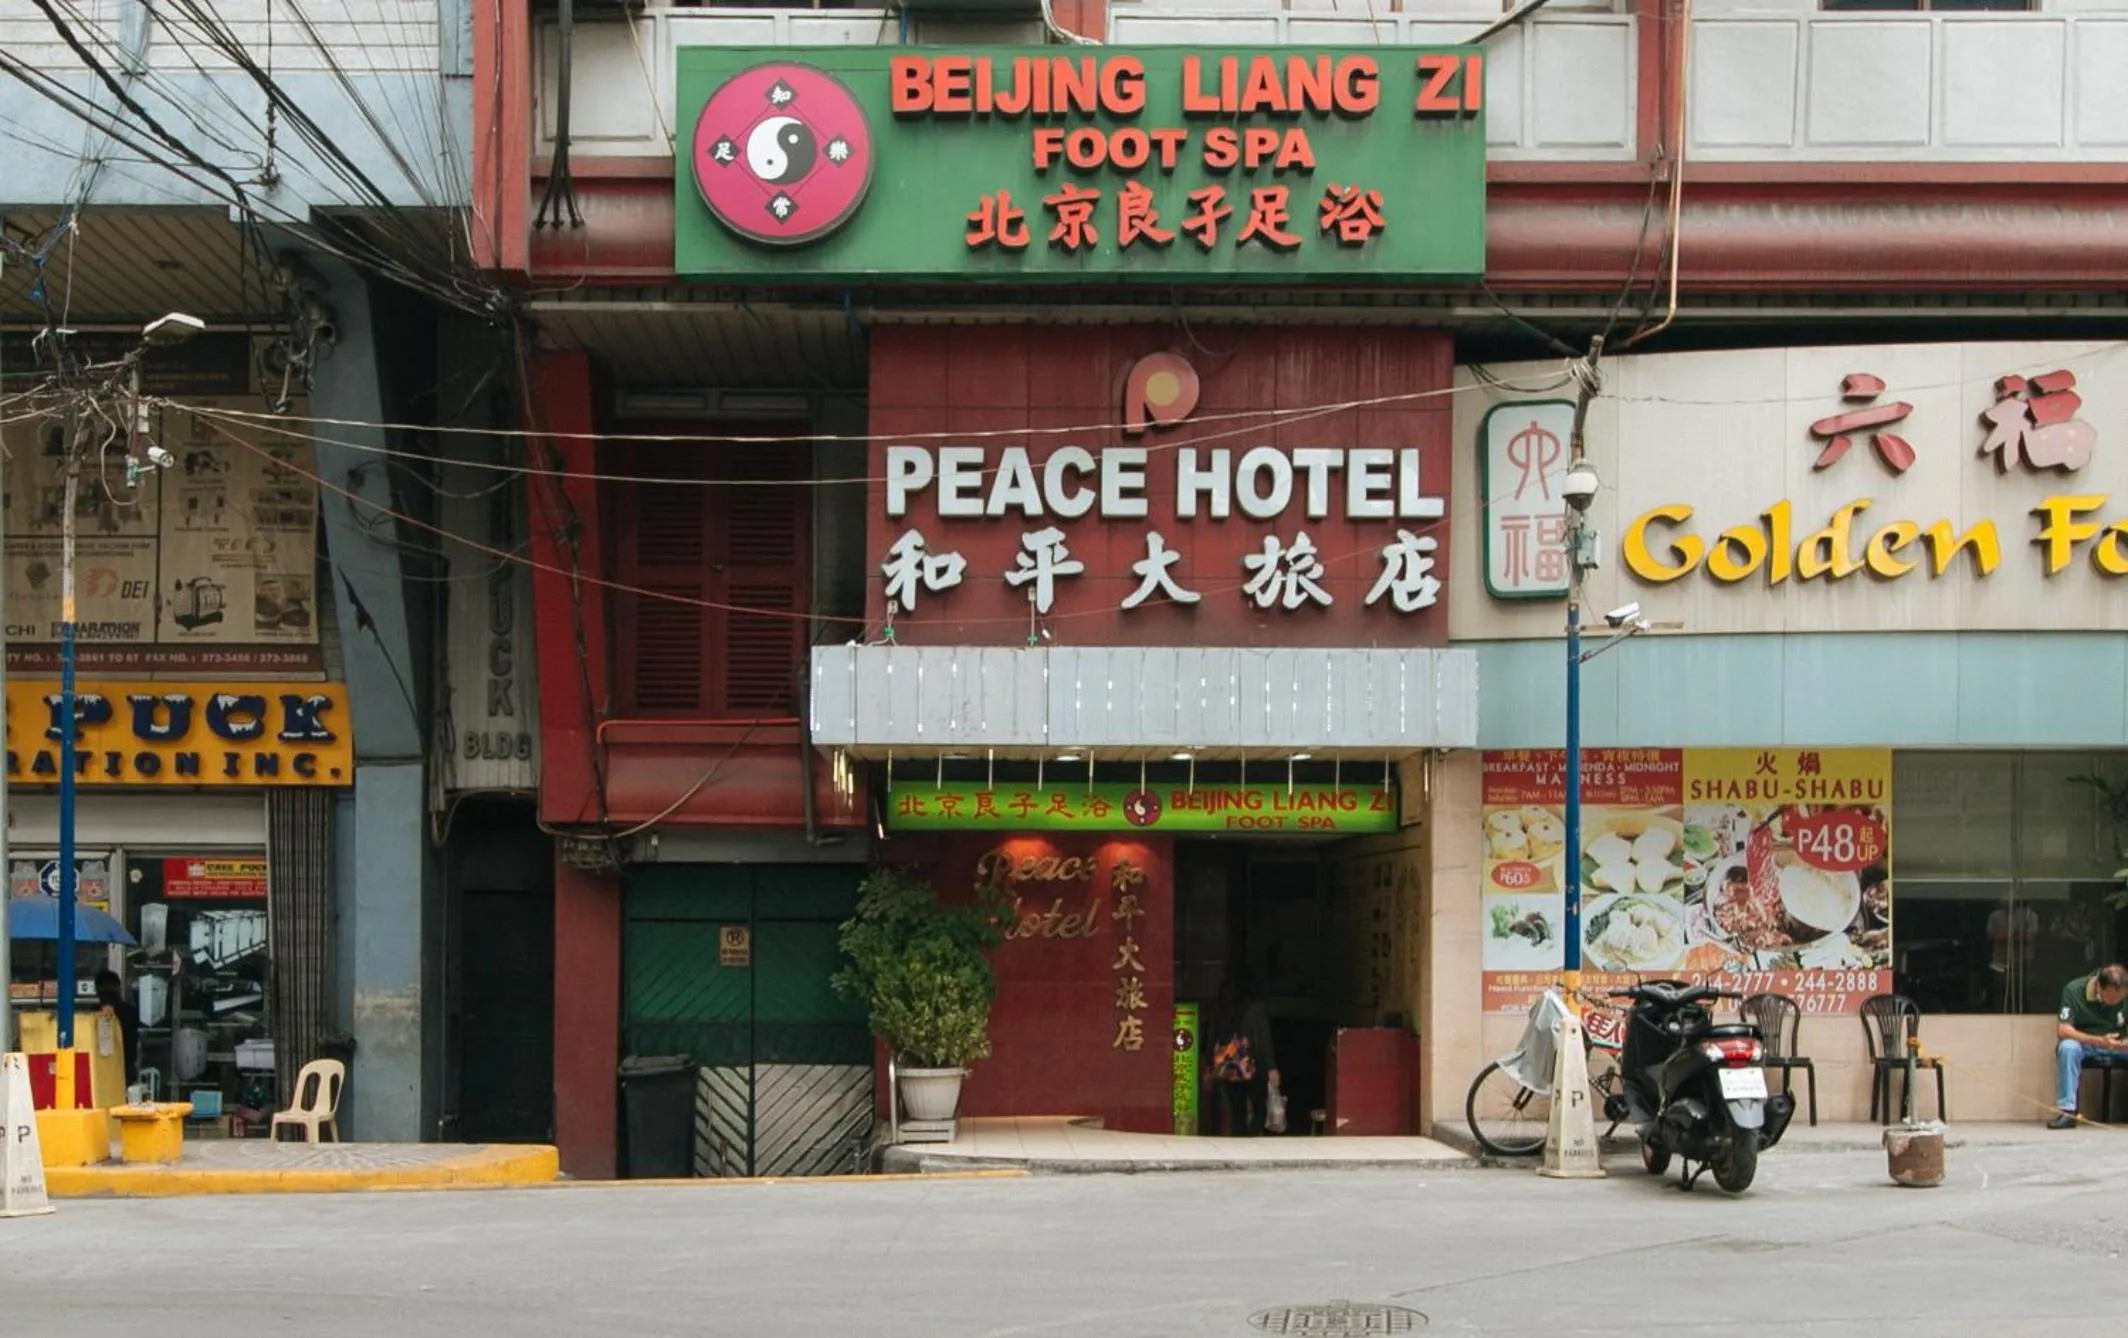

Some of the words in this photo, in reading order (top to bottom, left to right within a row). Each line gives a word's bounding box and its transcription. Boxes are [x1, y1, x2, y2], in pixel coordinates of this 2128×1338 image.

[771, 85, 793, 104] 知
[888, 54, 1147, 119] BEIJING
[1181, 54, 1381, 117] LIANG
[1414, 55, 1483, 117] ZI
[1032, 127, 1188, 171] FOOT
[1202, 127, 1317, 171] SPA
[964, 180, 1387, 248] 北京良子足浴
[1811, 370, 2099, 473] 六福
[886, 446, 1148, 518] PEACE
[1176, 446, 1444, 518] HOTEL
[1622, 497, 2001, 587] Golden
[881, 526, 1442, 613] 和平大旅店
[121, 580, 149, 599] DEI
[43, 692, 337, 744] PUCK
[463, 731, 533, 760] BLDG
[223, 750, 342, 778] INC.
[1624, 762, 1680, 773] MIDNIGHT
[1536, 772, 1627, 786] MANESS
[1690, 779, 1884, 800] SHABU-SHABU
[898, 791, 1113, 819] 北京良子足浴
[1170, 789, 1263, 814] BEIJING
[1273, 790, 1357, 812] LIANG
[1369, 790, 1394, 812] ZI
[1225, 815, 1288, 829] FOOT
[1297, 815, 1336, 829] SPA
[1857, 844, 1879, 862] UP
[1112, 858, 1149, 1052] 和平大旅店
[1794, 972, 1878, 992] 244-2888
[1571, 1090, 1584, 1108] P
[17, 1125, 31, 1144] P
